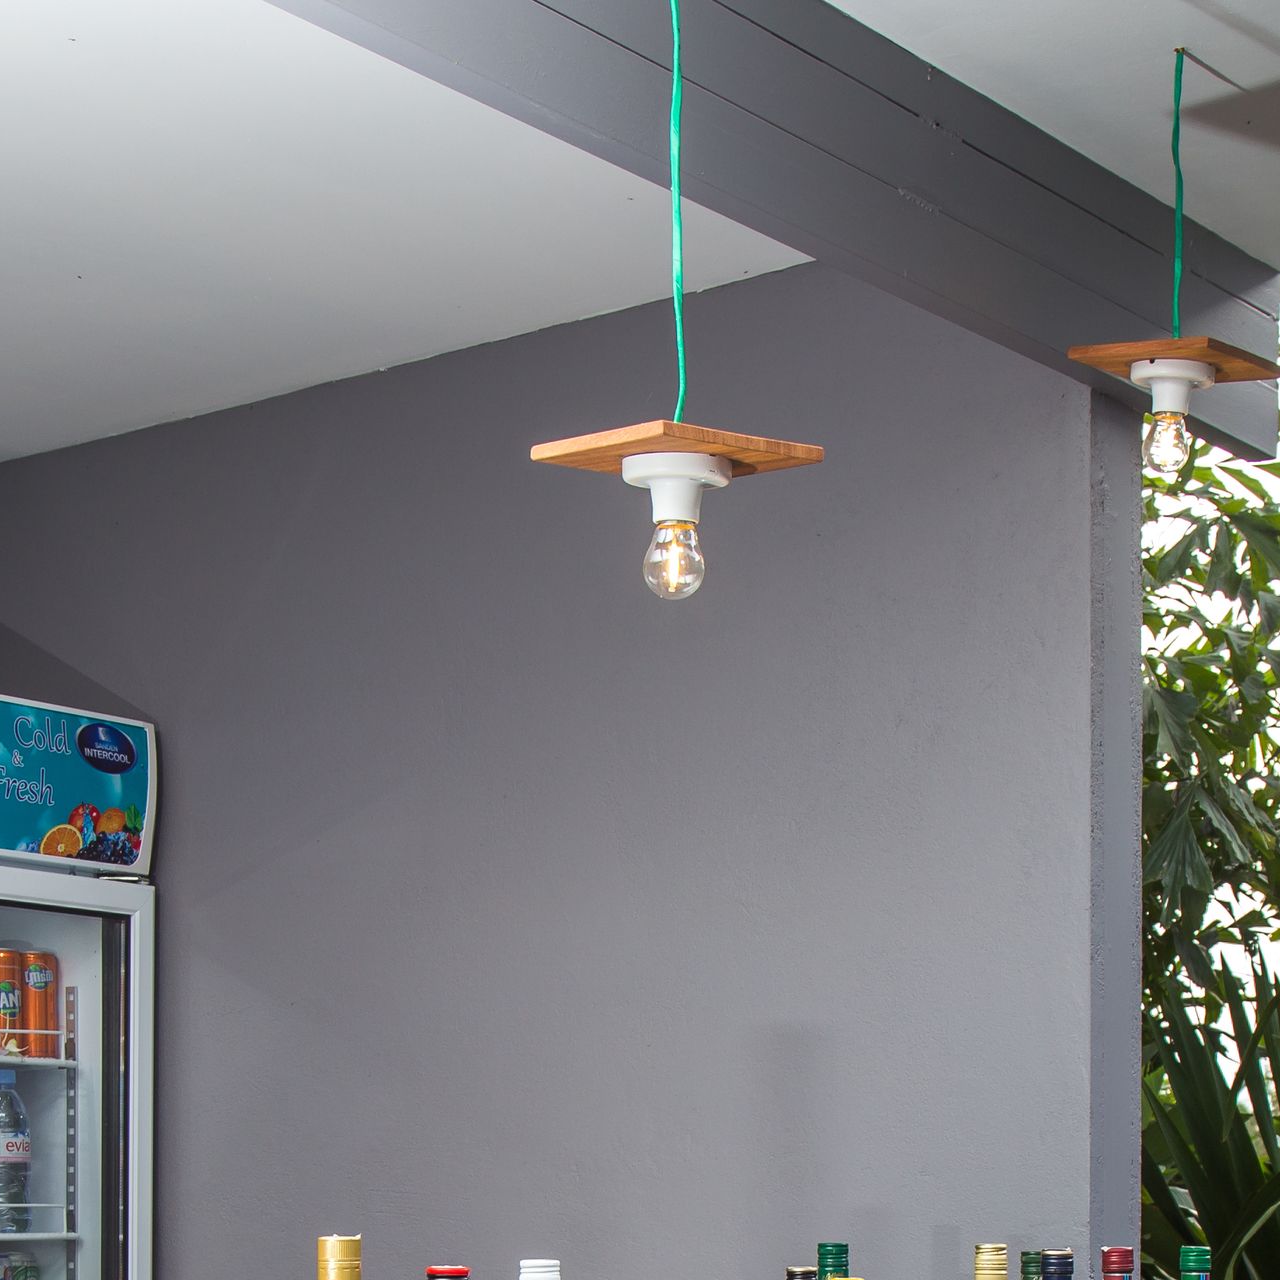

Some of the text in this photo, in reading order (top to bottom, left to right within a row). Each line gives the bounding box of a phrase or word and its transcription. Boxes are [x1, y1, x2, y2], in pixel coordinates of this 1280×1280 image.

[14, 715, 71, 755] Cold
[12, 749, 24, 767] &
[84, 747, 131, 765] INTERCOOL
